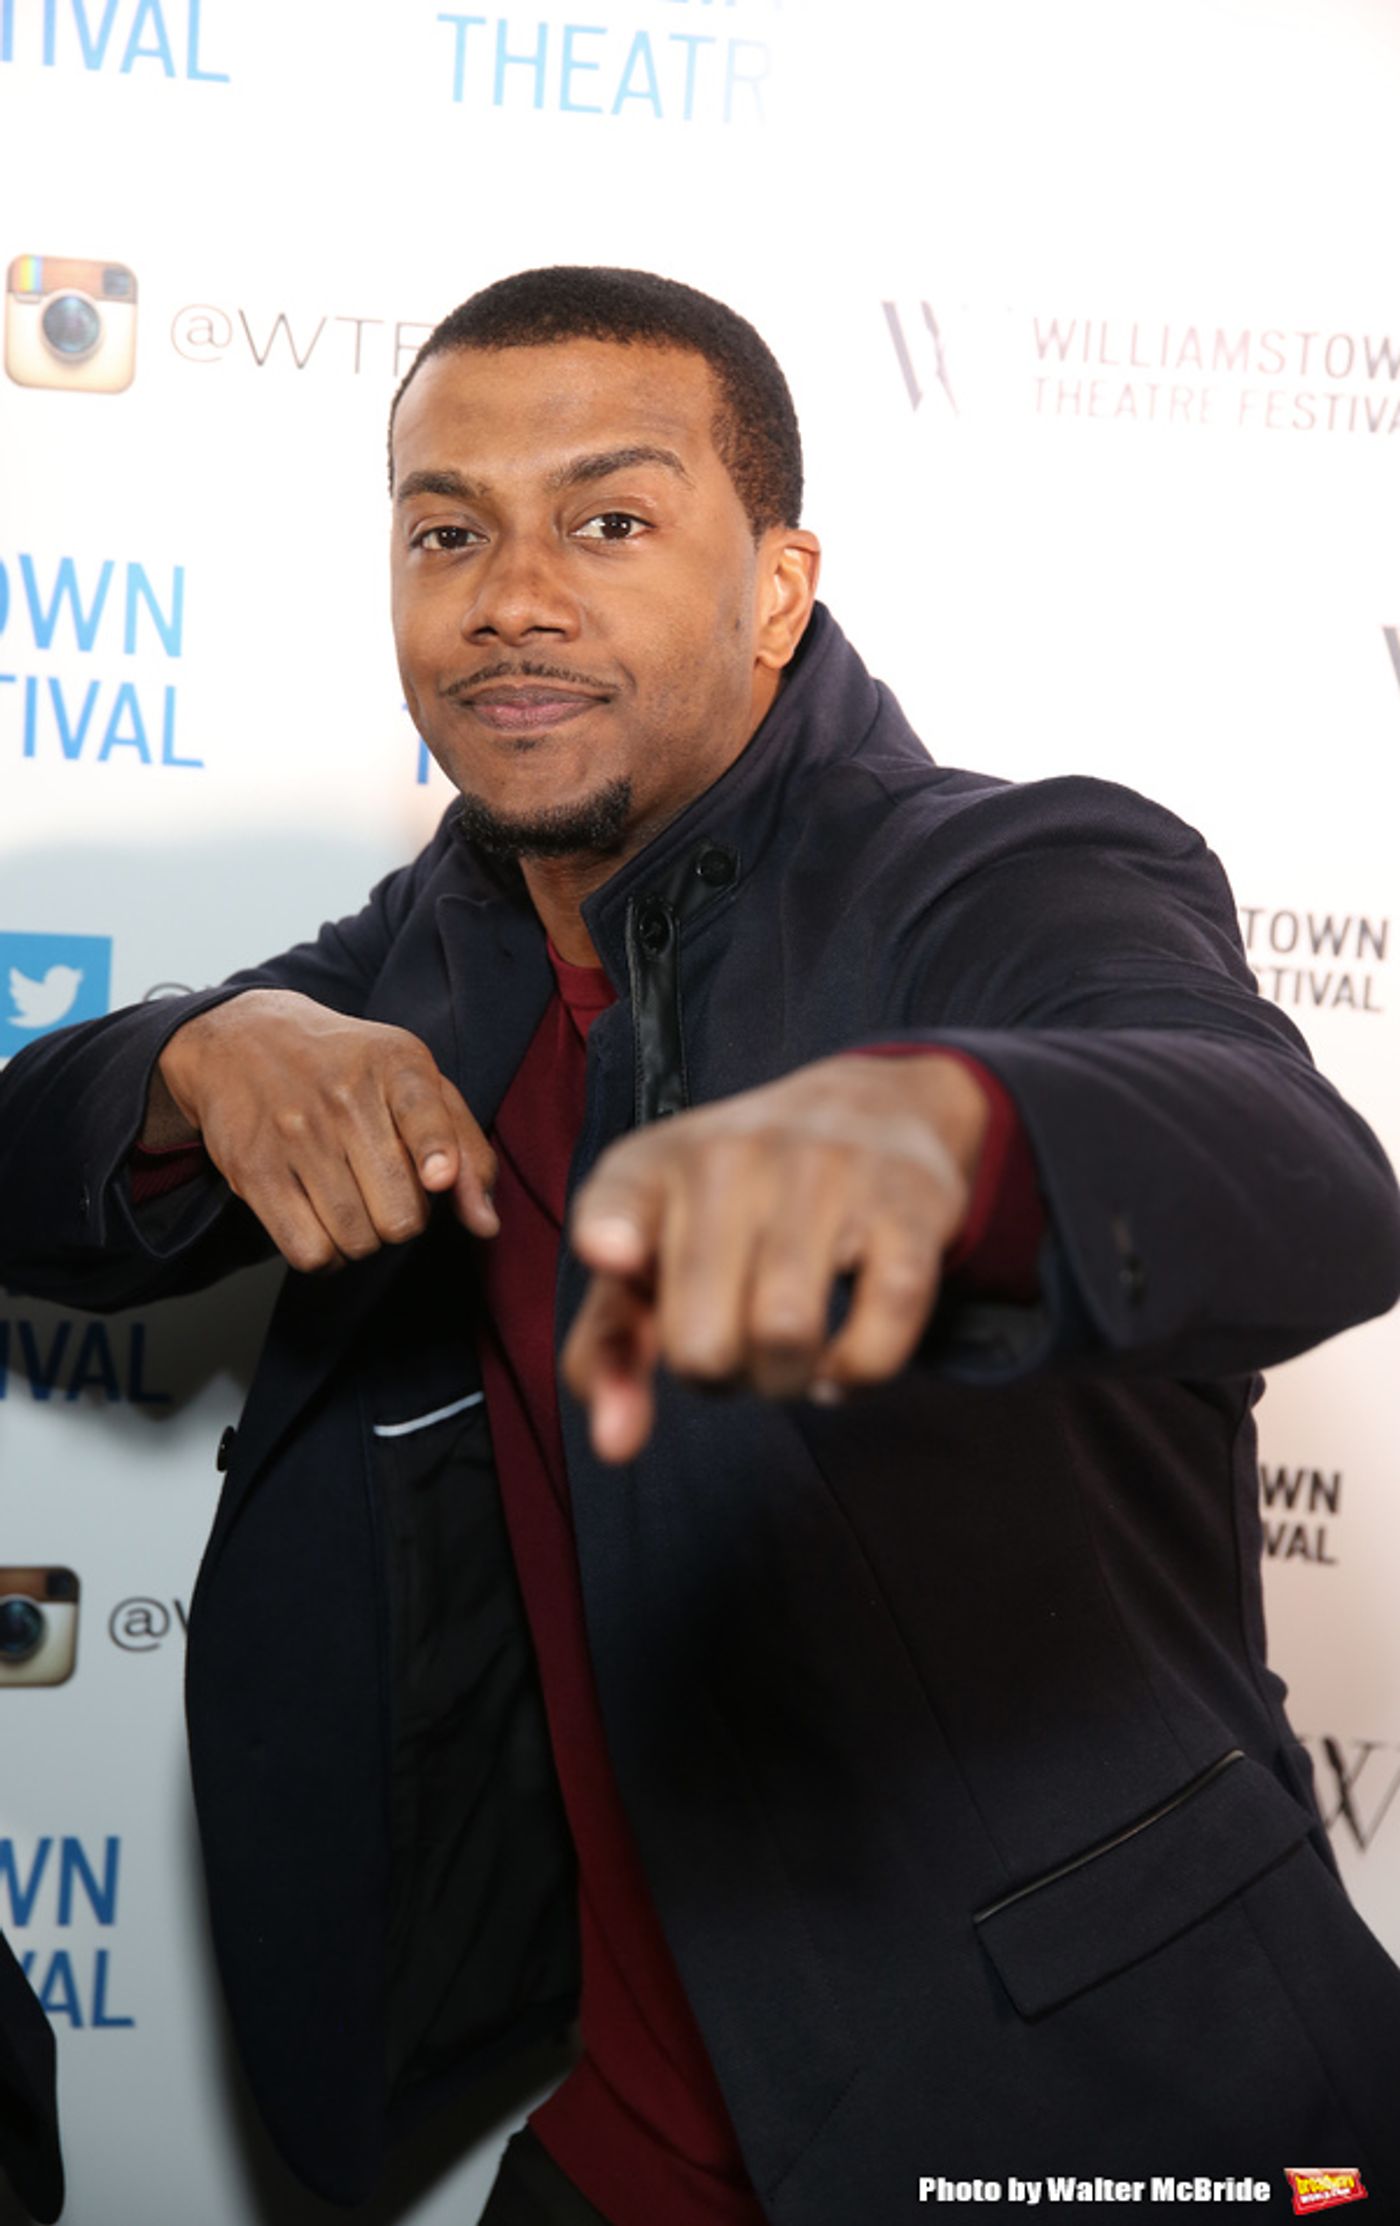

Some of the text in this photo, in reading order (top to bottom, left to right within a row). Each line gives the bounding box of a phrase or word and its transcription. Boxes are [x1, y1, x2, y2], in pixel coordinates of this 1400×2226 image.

[437, 12, 770, 127] THEATR
[1032, 376, 1213, 425] THEATRE
[0, 553, 185, 658] WN
[1240, 906, 1389, 960] TOWN
[1251, 964, 1384, 1013] TIVAL
[1260, 1464, 1341, 1515] WN
[22, 1949, 136, 2030] AL
